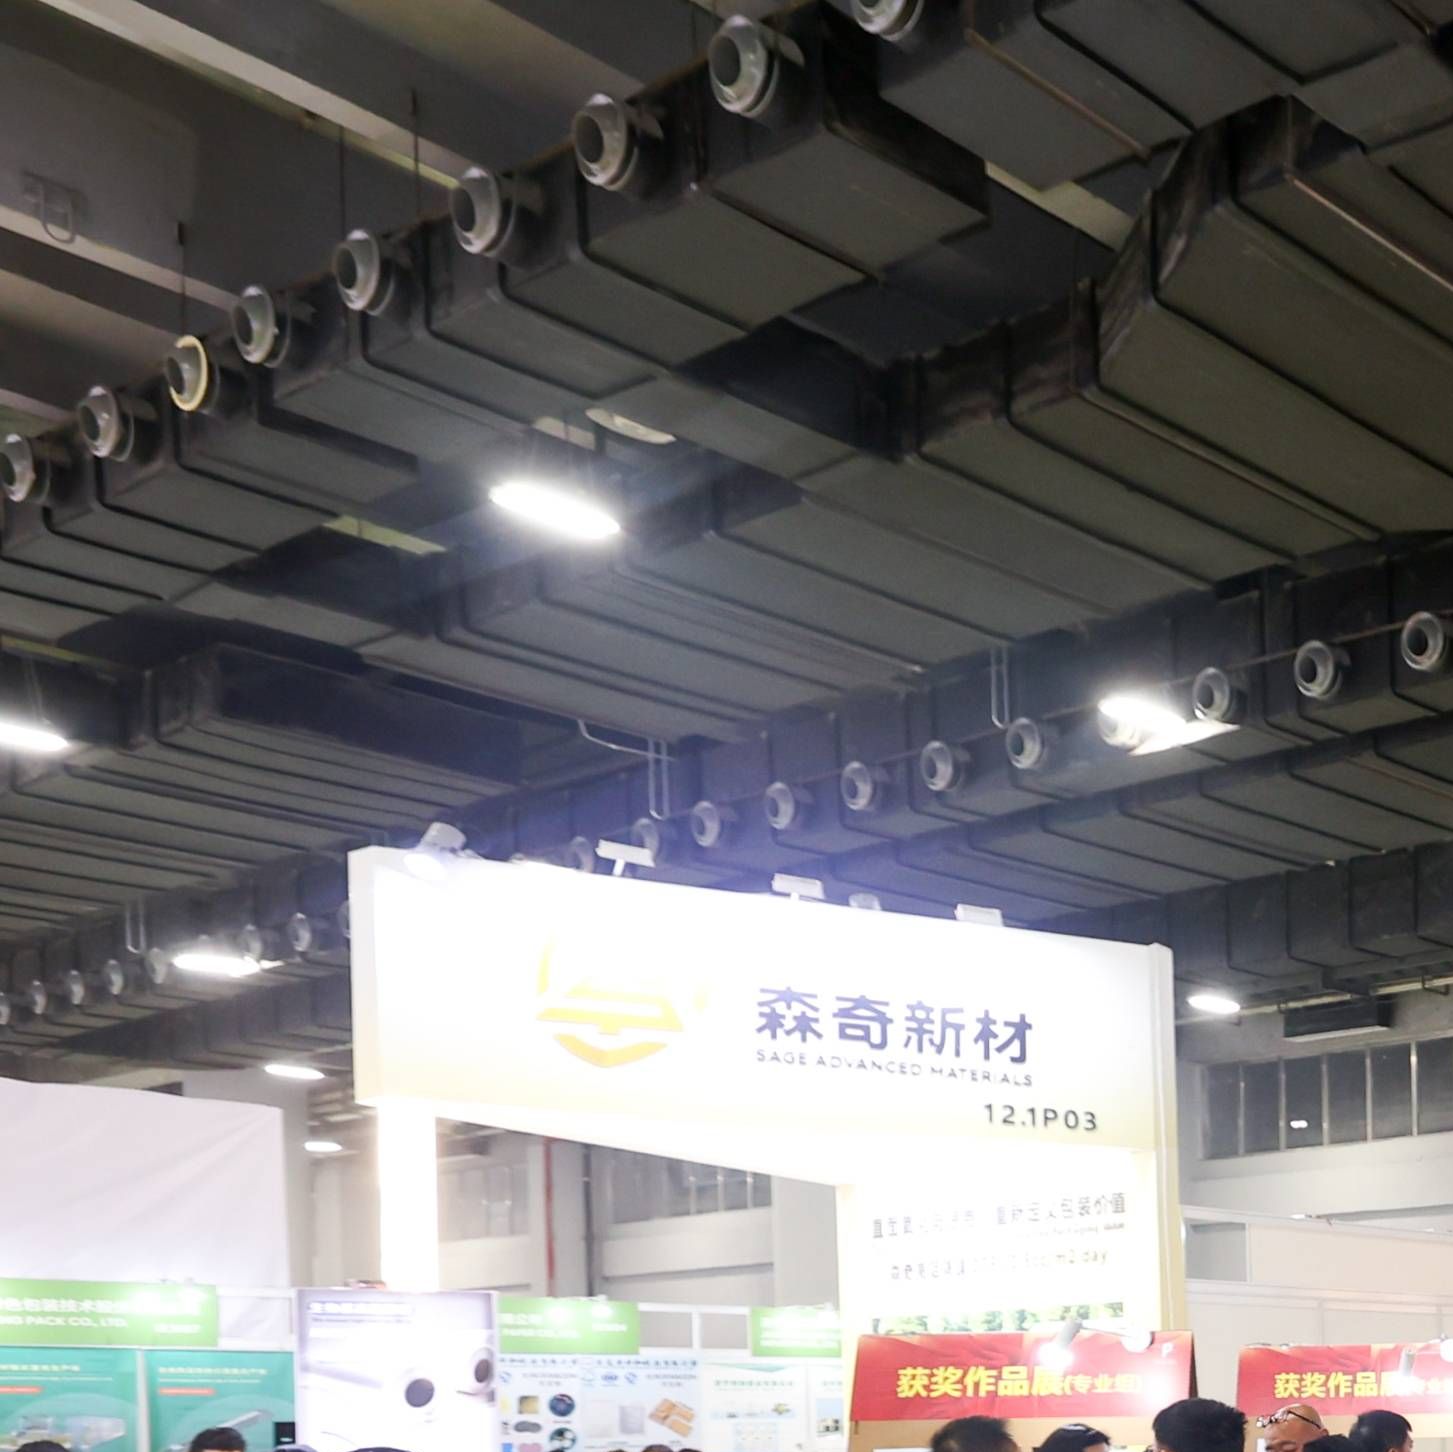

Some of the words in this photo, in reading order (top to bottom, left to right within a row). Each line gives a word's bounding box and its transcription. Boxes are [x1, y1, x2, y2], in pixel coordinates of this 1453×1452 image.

[755, 986, 1034, 1065] 森奇新材
[756, 1049, 808, 1066] SAGE
[816, 1056, 922, 1077] ADVANCED
[930, 1065, 1033, 1087] MATERIALS
[984, 1102, 1098, 1132] 12.1P03
